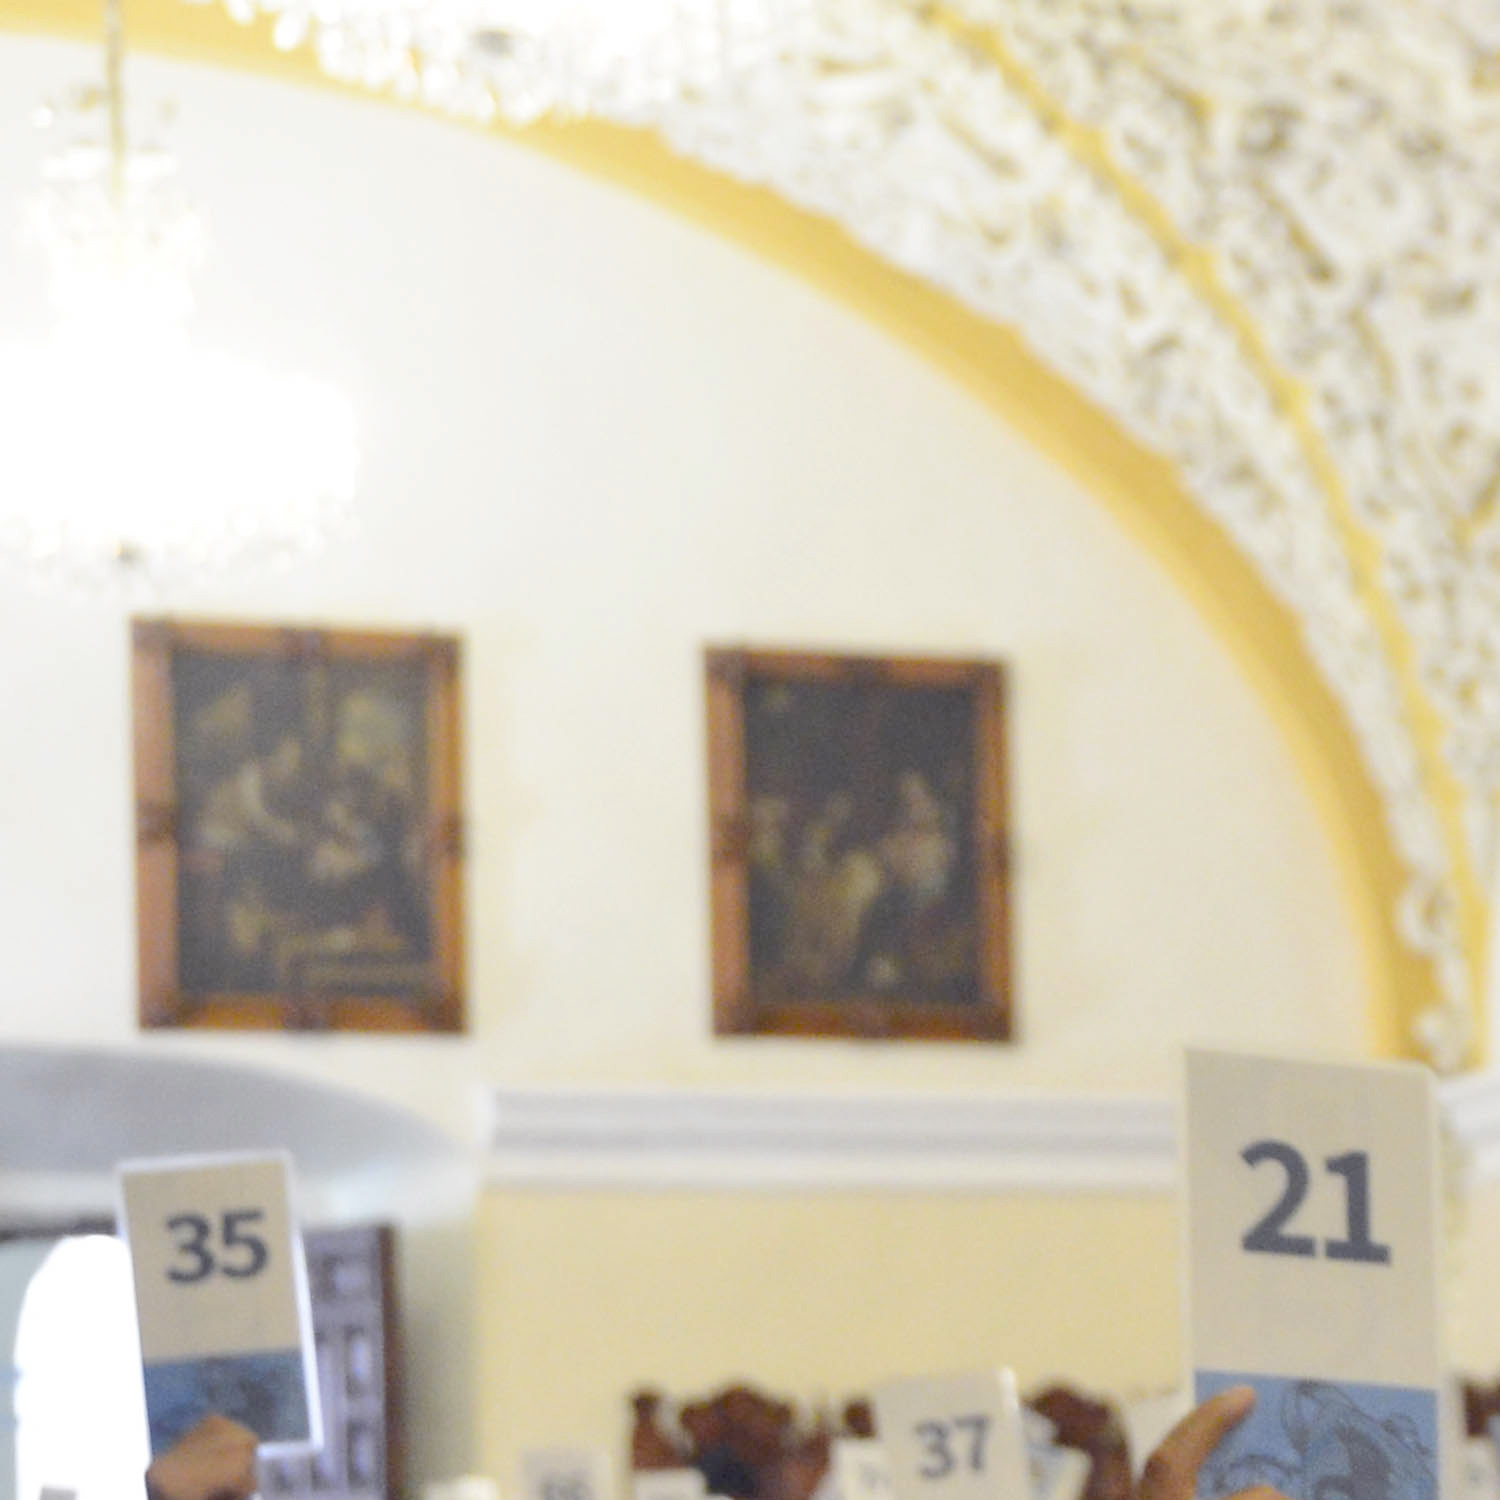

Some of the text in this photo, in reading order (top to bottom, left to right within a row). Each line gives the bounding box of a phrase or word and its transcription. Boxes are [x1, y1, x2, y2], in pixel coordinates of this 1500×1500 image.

[1241, 1141, 1390, 1264] 21
[166, 1210, 268, 1285] 35
[915, 1415, 990, 1479] 37
